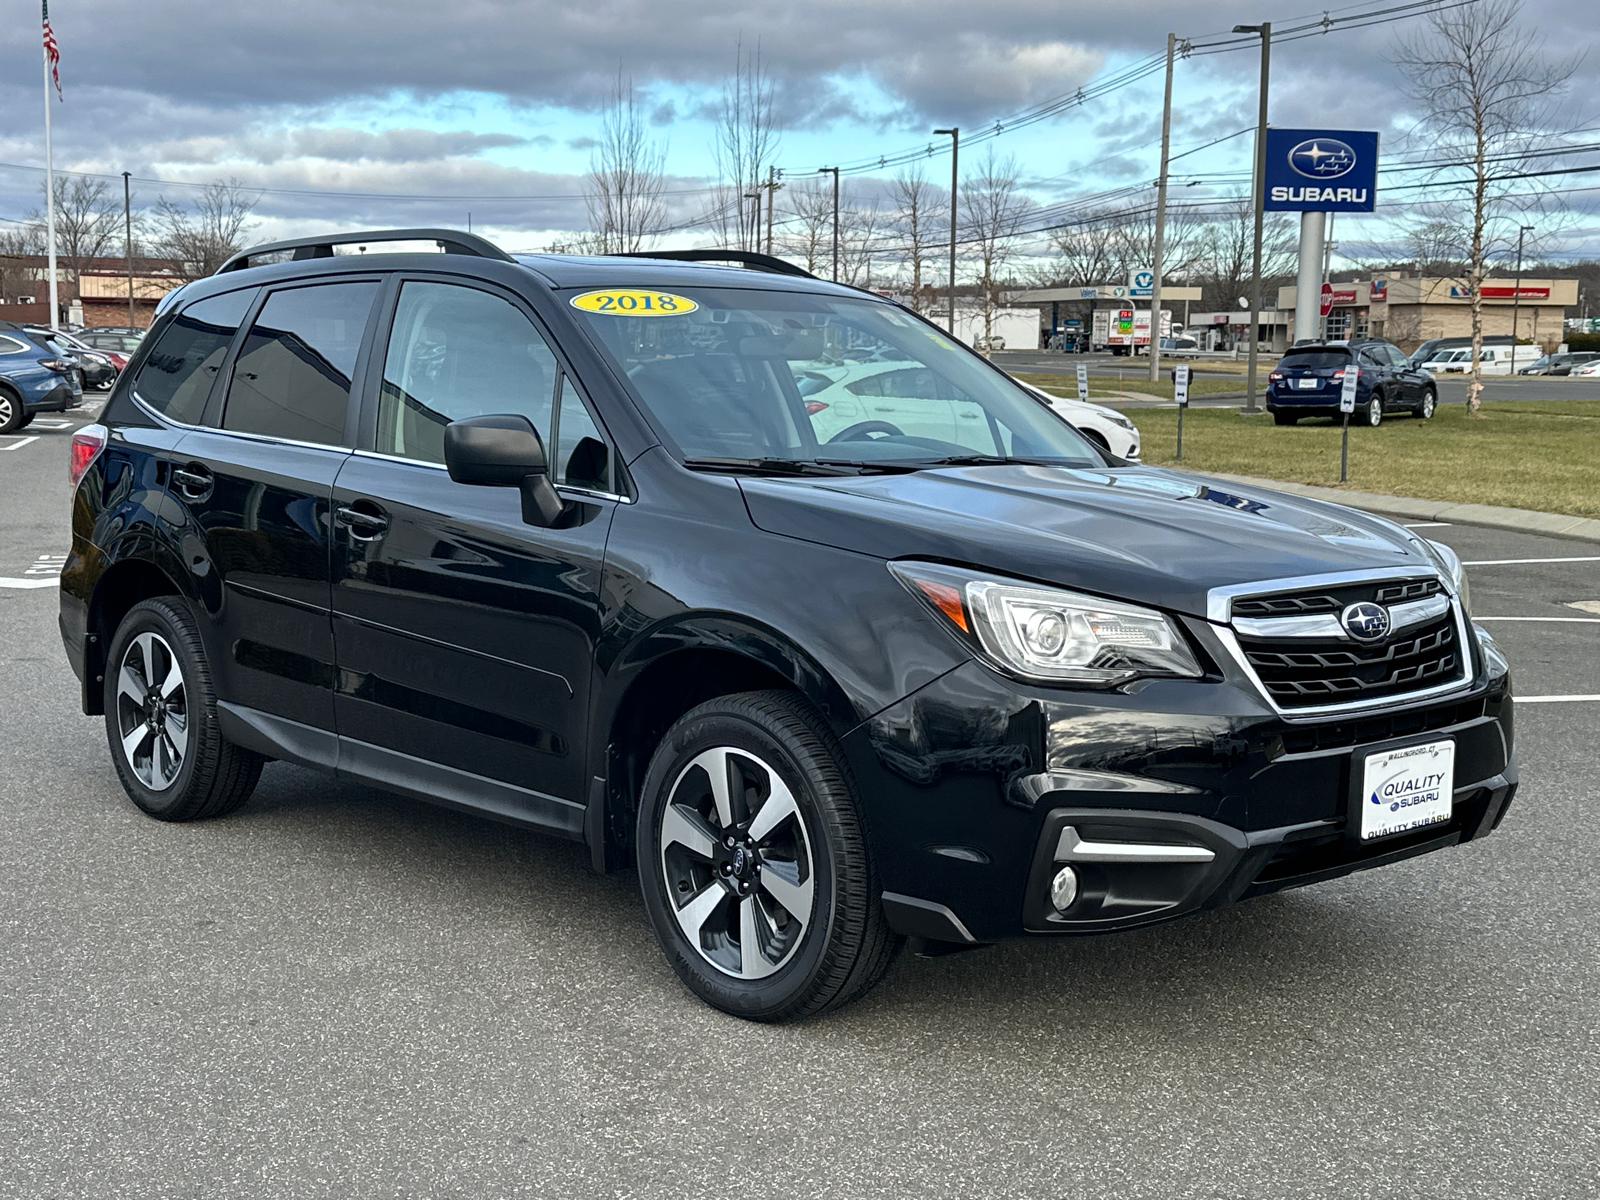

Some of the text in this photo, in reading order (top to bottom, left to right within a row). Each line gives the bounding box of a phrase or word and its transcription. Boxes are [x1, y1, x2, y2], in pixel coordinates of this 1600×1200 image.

[1271, 186, 1367, 203] SUBARU
[1081, 287, 1096, 298] Valero
[1321, 293, 1332, 306] TOP
[596, 295, 678, 311] 2018
[1384, 772, 1445, 796] QUALITY
[1400, 791, 1439, 808] SUBARU
[1367, 813, 1450, 839] QUALITY SUBARU
